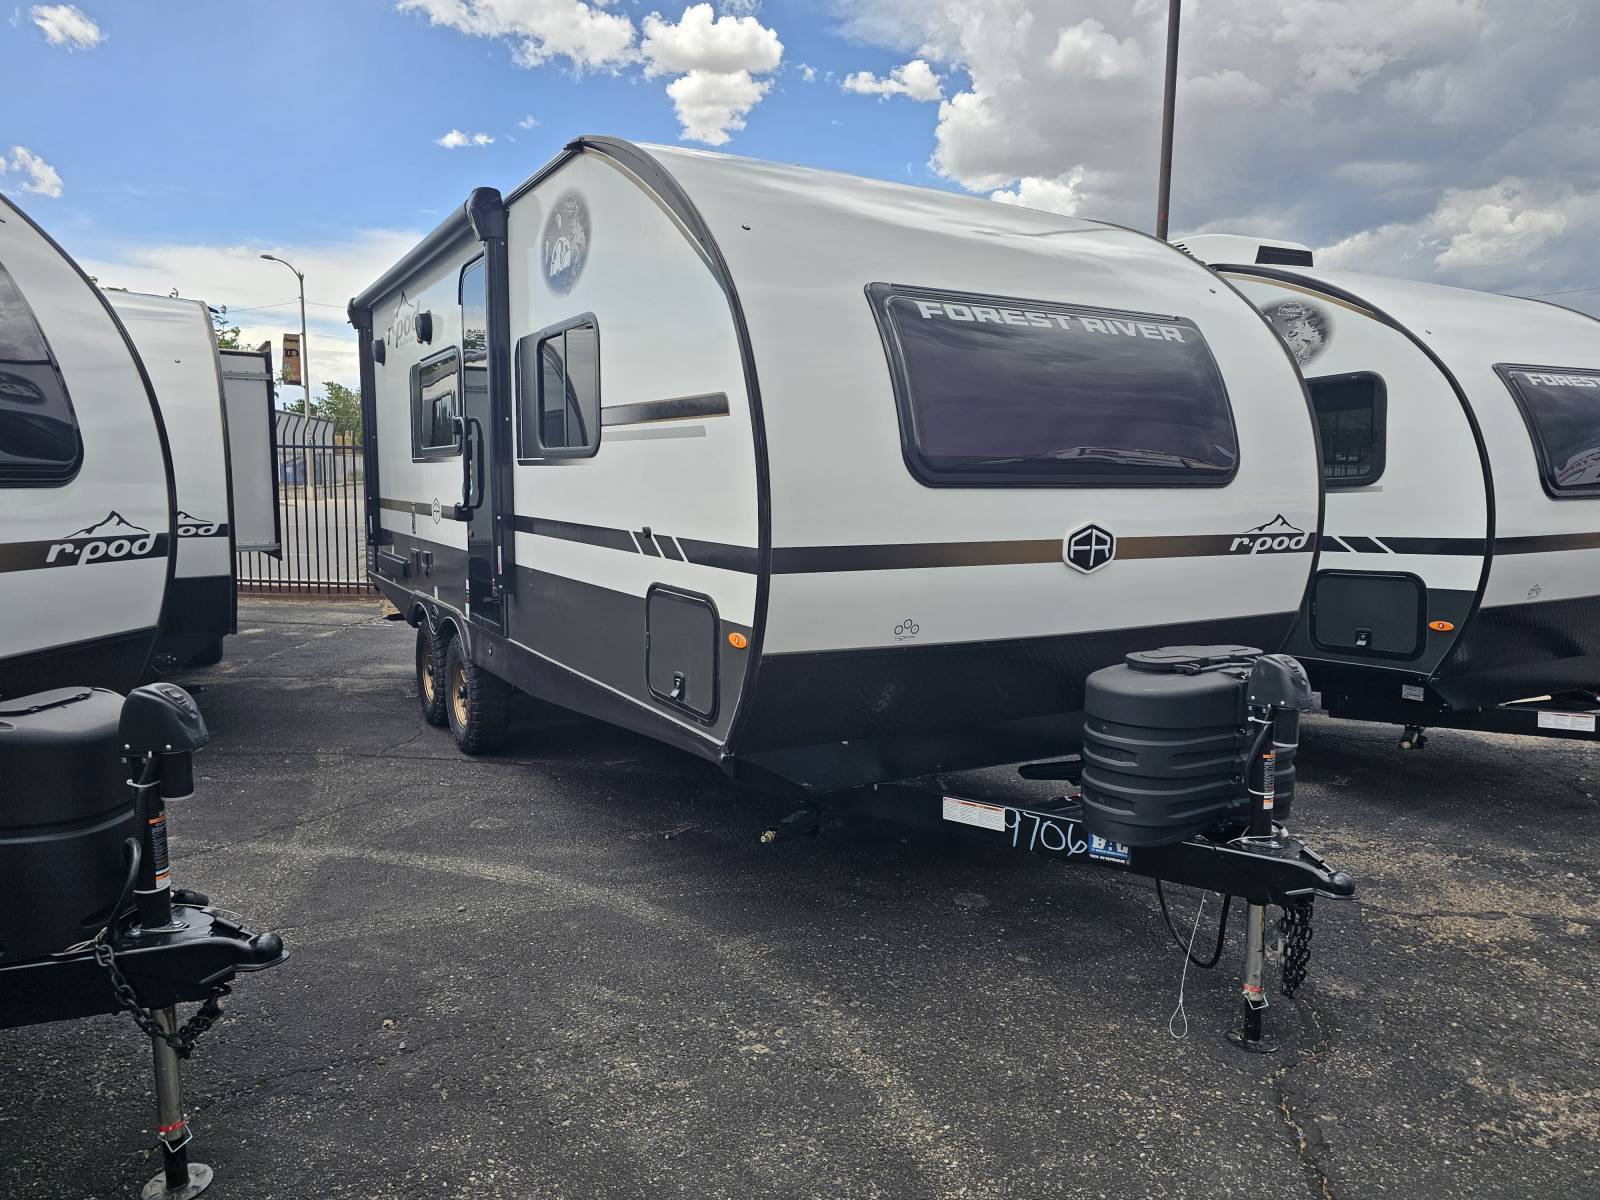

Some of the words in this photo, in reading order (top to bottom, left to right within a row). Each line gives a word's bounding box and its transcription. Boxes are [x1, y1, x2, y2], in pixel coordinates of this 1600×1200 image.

[914, 300, 1072, 330] FOREST
[1078, 316, 1187, 343] RIVER
[1523, 372, 1600, 388] FORES
[1004, 807, 1088, 857] 9706
